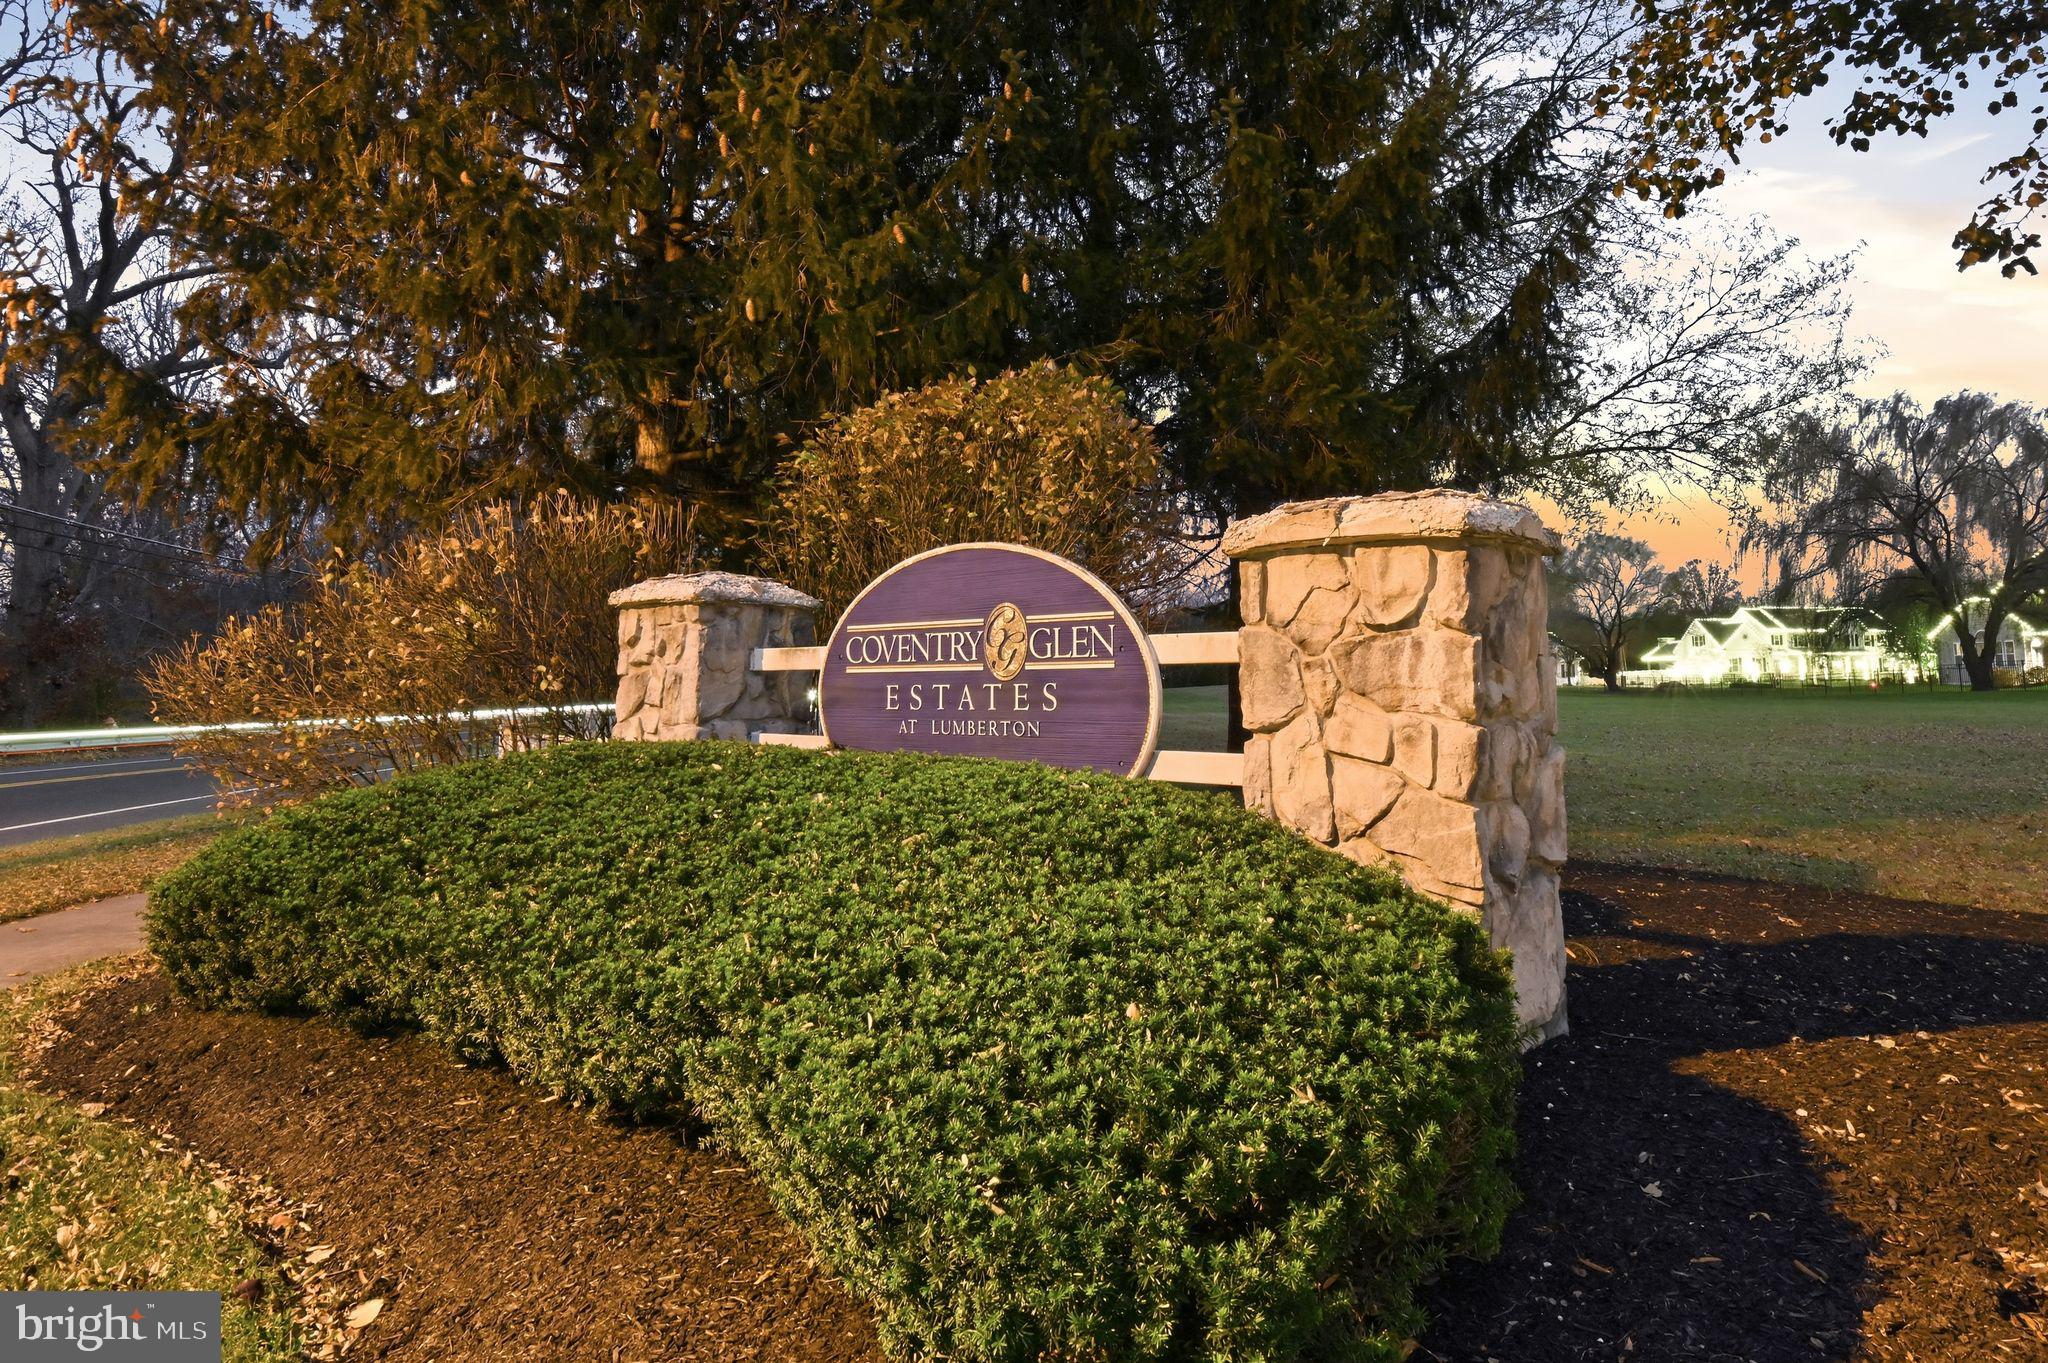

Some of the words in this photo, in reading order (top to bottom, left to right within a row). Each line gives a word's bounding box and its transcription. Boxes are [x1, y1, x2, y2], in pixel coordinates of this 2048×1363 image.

[846, 630, 984, 664] COVENTRY
[1029, 624, 1115, 660] GLEN
[885, 682, 1058, 712] ESTATES
[899, 720, 918, 735] AT
[931, 720, 1041, 737] LUMBERTON
